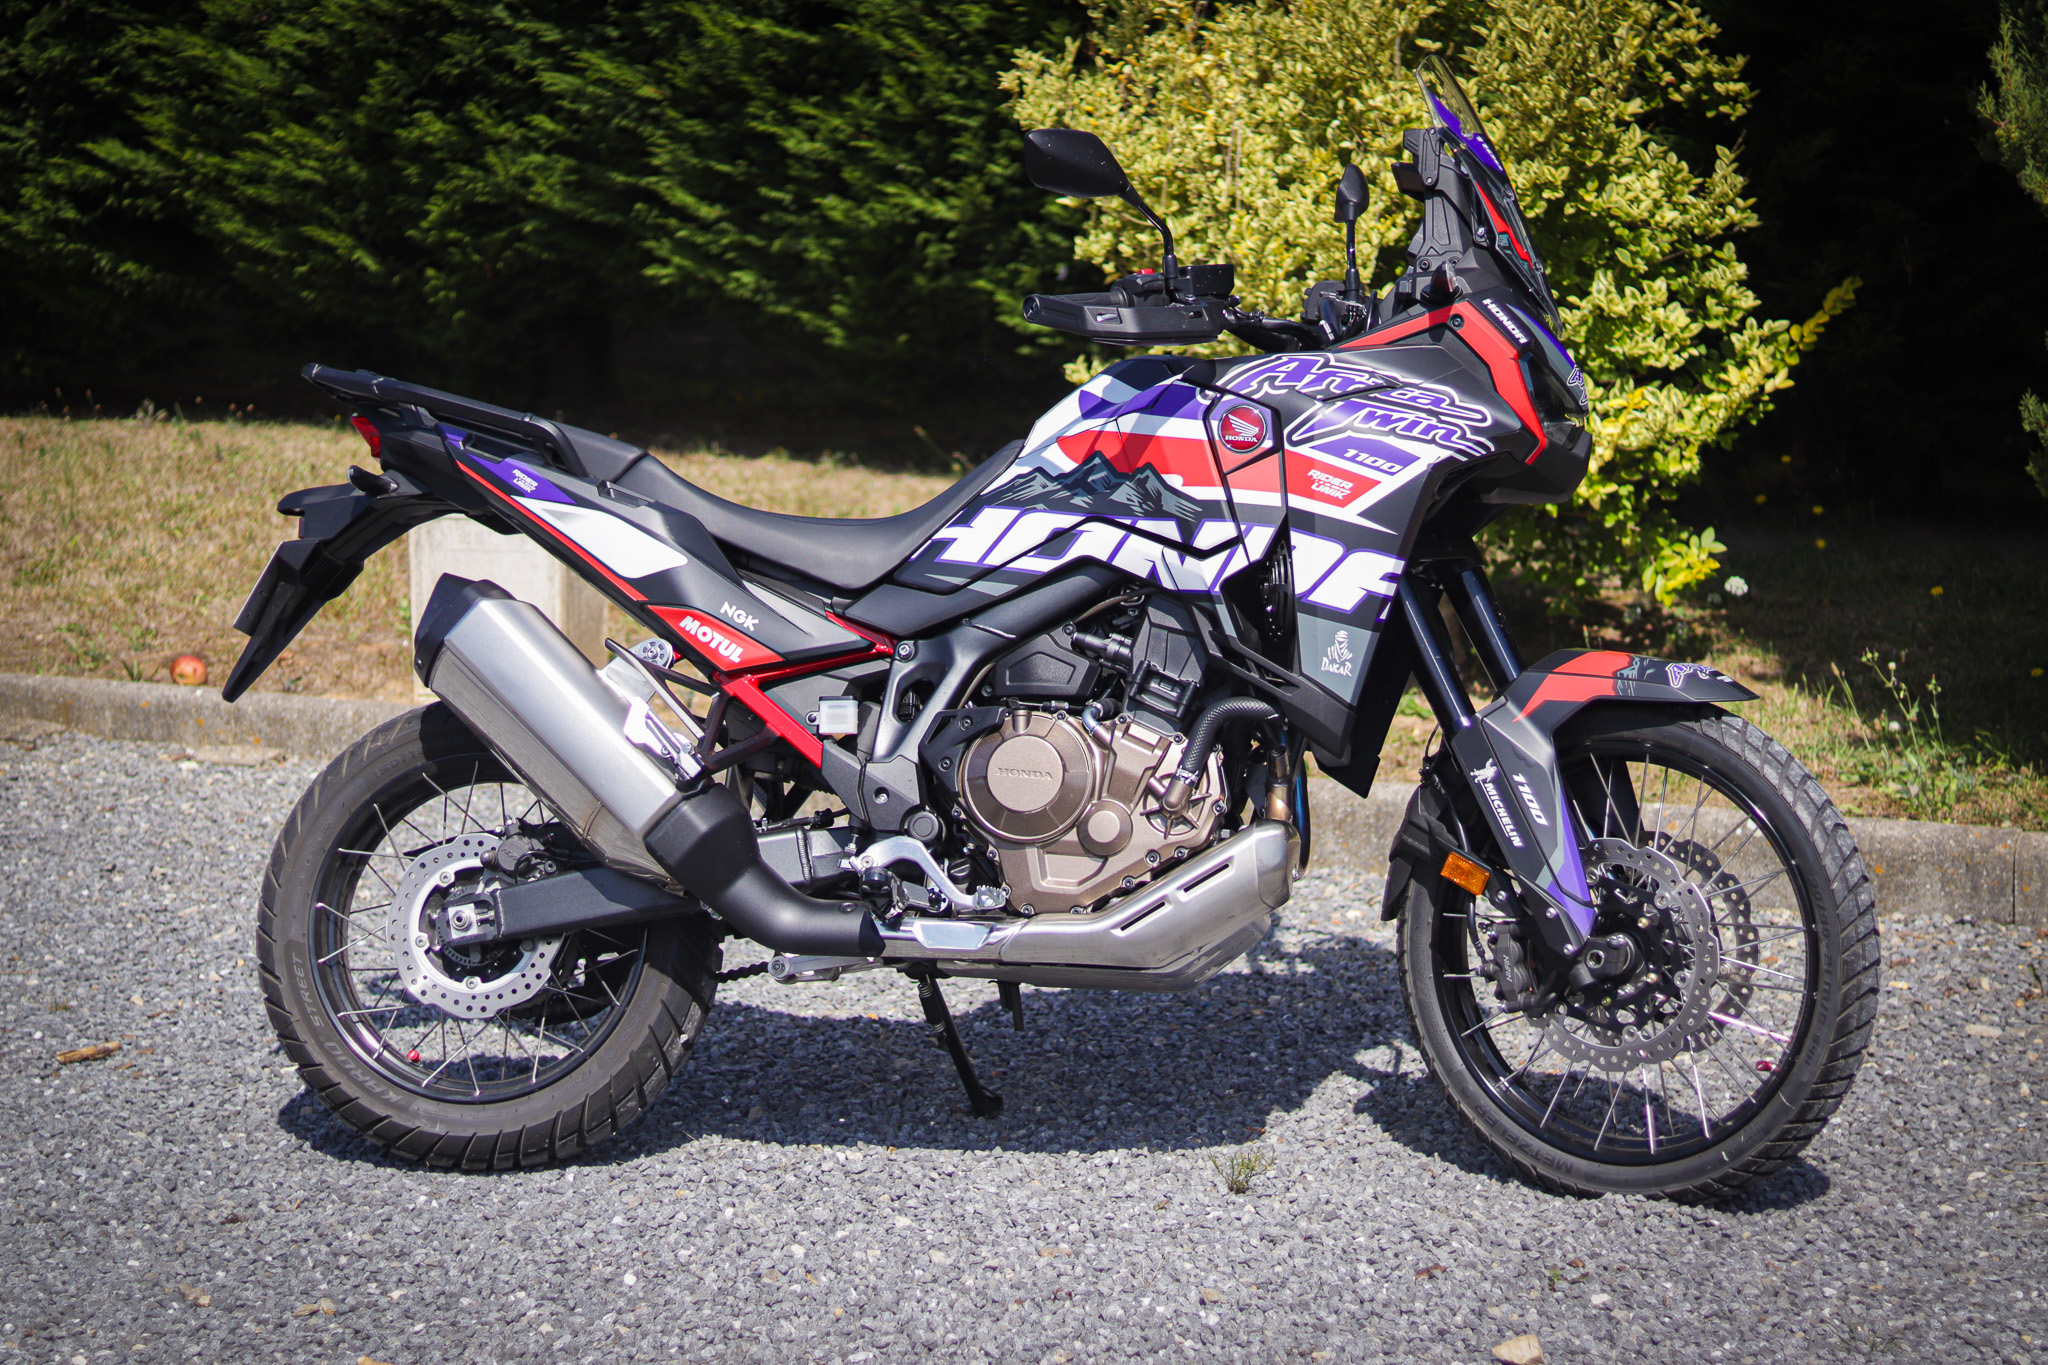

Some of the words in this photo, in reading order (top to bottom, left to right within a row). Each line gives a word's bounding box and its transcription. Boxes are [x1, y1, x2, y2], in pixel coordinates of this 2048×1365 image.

[1482, 299, 1528, 343] HONDA
[1291, 397, 1488, 453] Twin
[512, 469, 539, 487] RIDER
[1307, 469, 1353, 490] RIDER
[1343, 448, 1403, 473] 1100
[1311, 482, 1350, 499] UNIK
[909, 505, 1405, 621] HONDA
[679, 615, 744, 663] MOTUL
[720, 601, 759, 631] NGK
[1321, 656, 1352, 677] DAKAR
[996, 767, 1054, 780] HONDA
[1484, 783, 1524, 847] MICHELIN
[1512, 773, 1548, 825] 1100
[292, 952, 325, 1028] STREET
[323, 1041, 405, 1104] KAROO
[1475, 1103, 1575, 1175] METZELER
